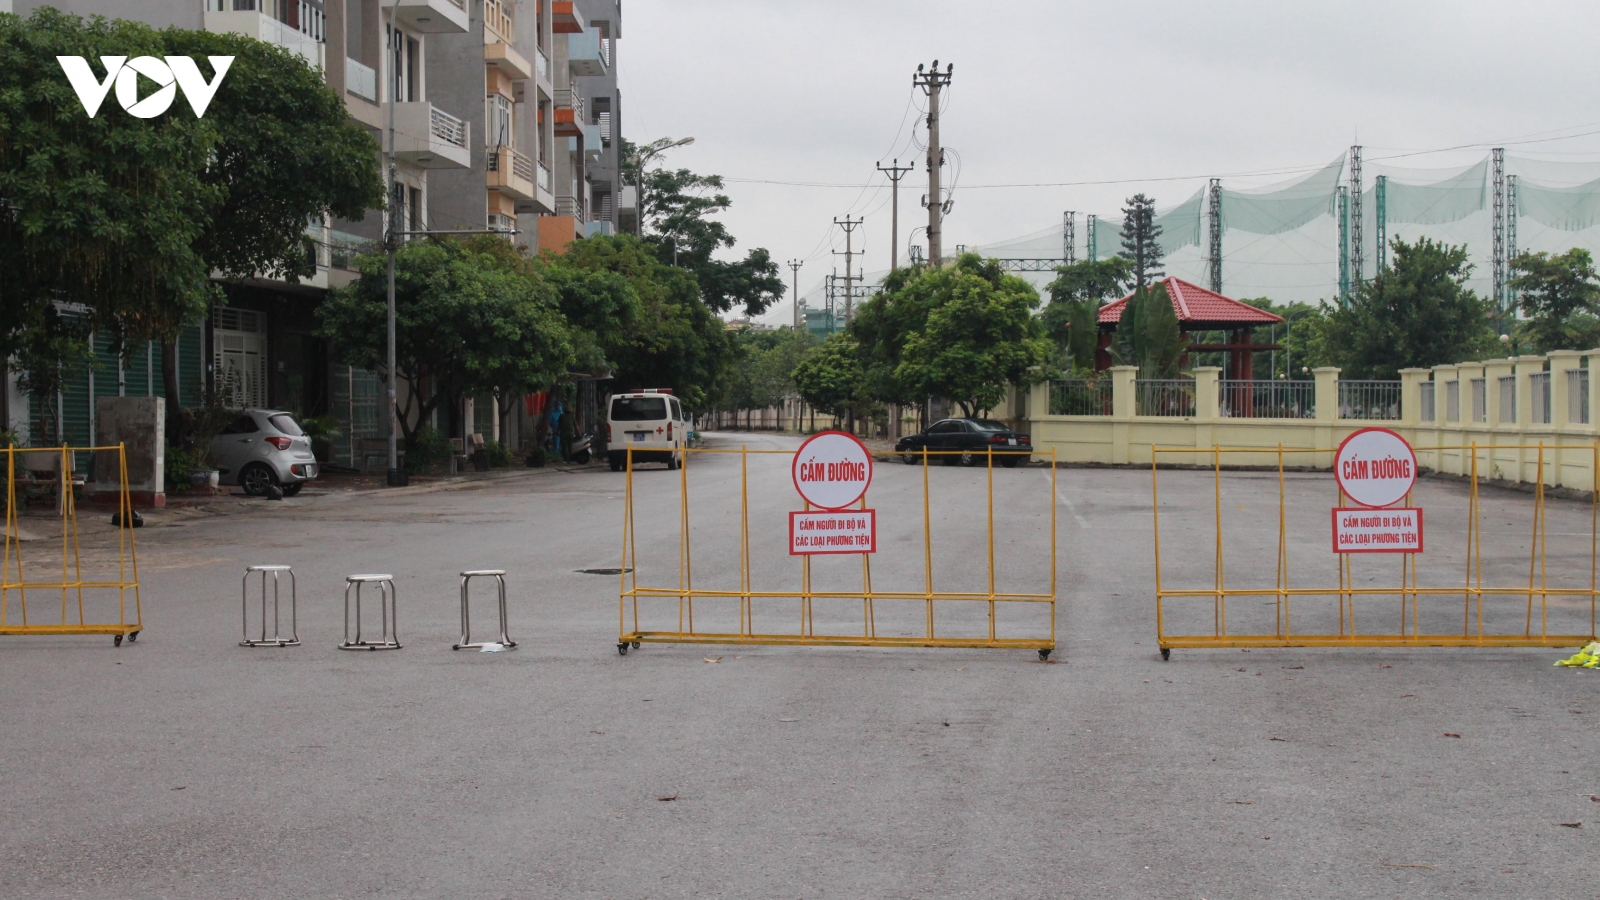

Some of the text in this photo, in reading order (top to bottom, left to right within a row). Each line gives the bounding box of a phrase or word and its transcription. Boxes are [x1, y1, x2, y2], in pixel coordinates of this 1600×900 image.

[800, 456, 865, 482] CẤM ĐƯỜNG
[1343, 454, 1410, 480] CẤM ĐƯỜNG
[799, 517, 866, 531] CẤM NGƯỜI ĐI BỘ VÀ
[1343, 514, 1412, 529] CẤM NGƯỜI ĐI BỘ VÀ
[795, 533, 870, 548] CÁC LOẠI PHƯƠNG TIỆN
[1340, 531, 1417, 546] CÁC LOẠI PHƯƠNG TIỆN
